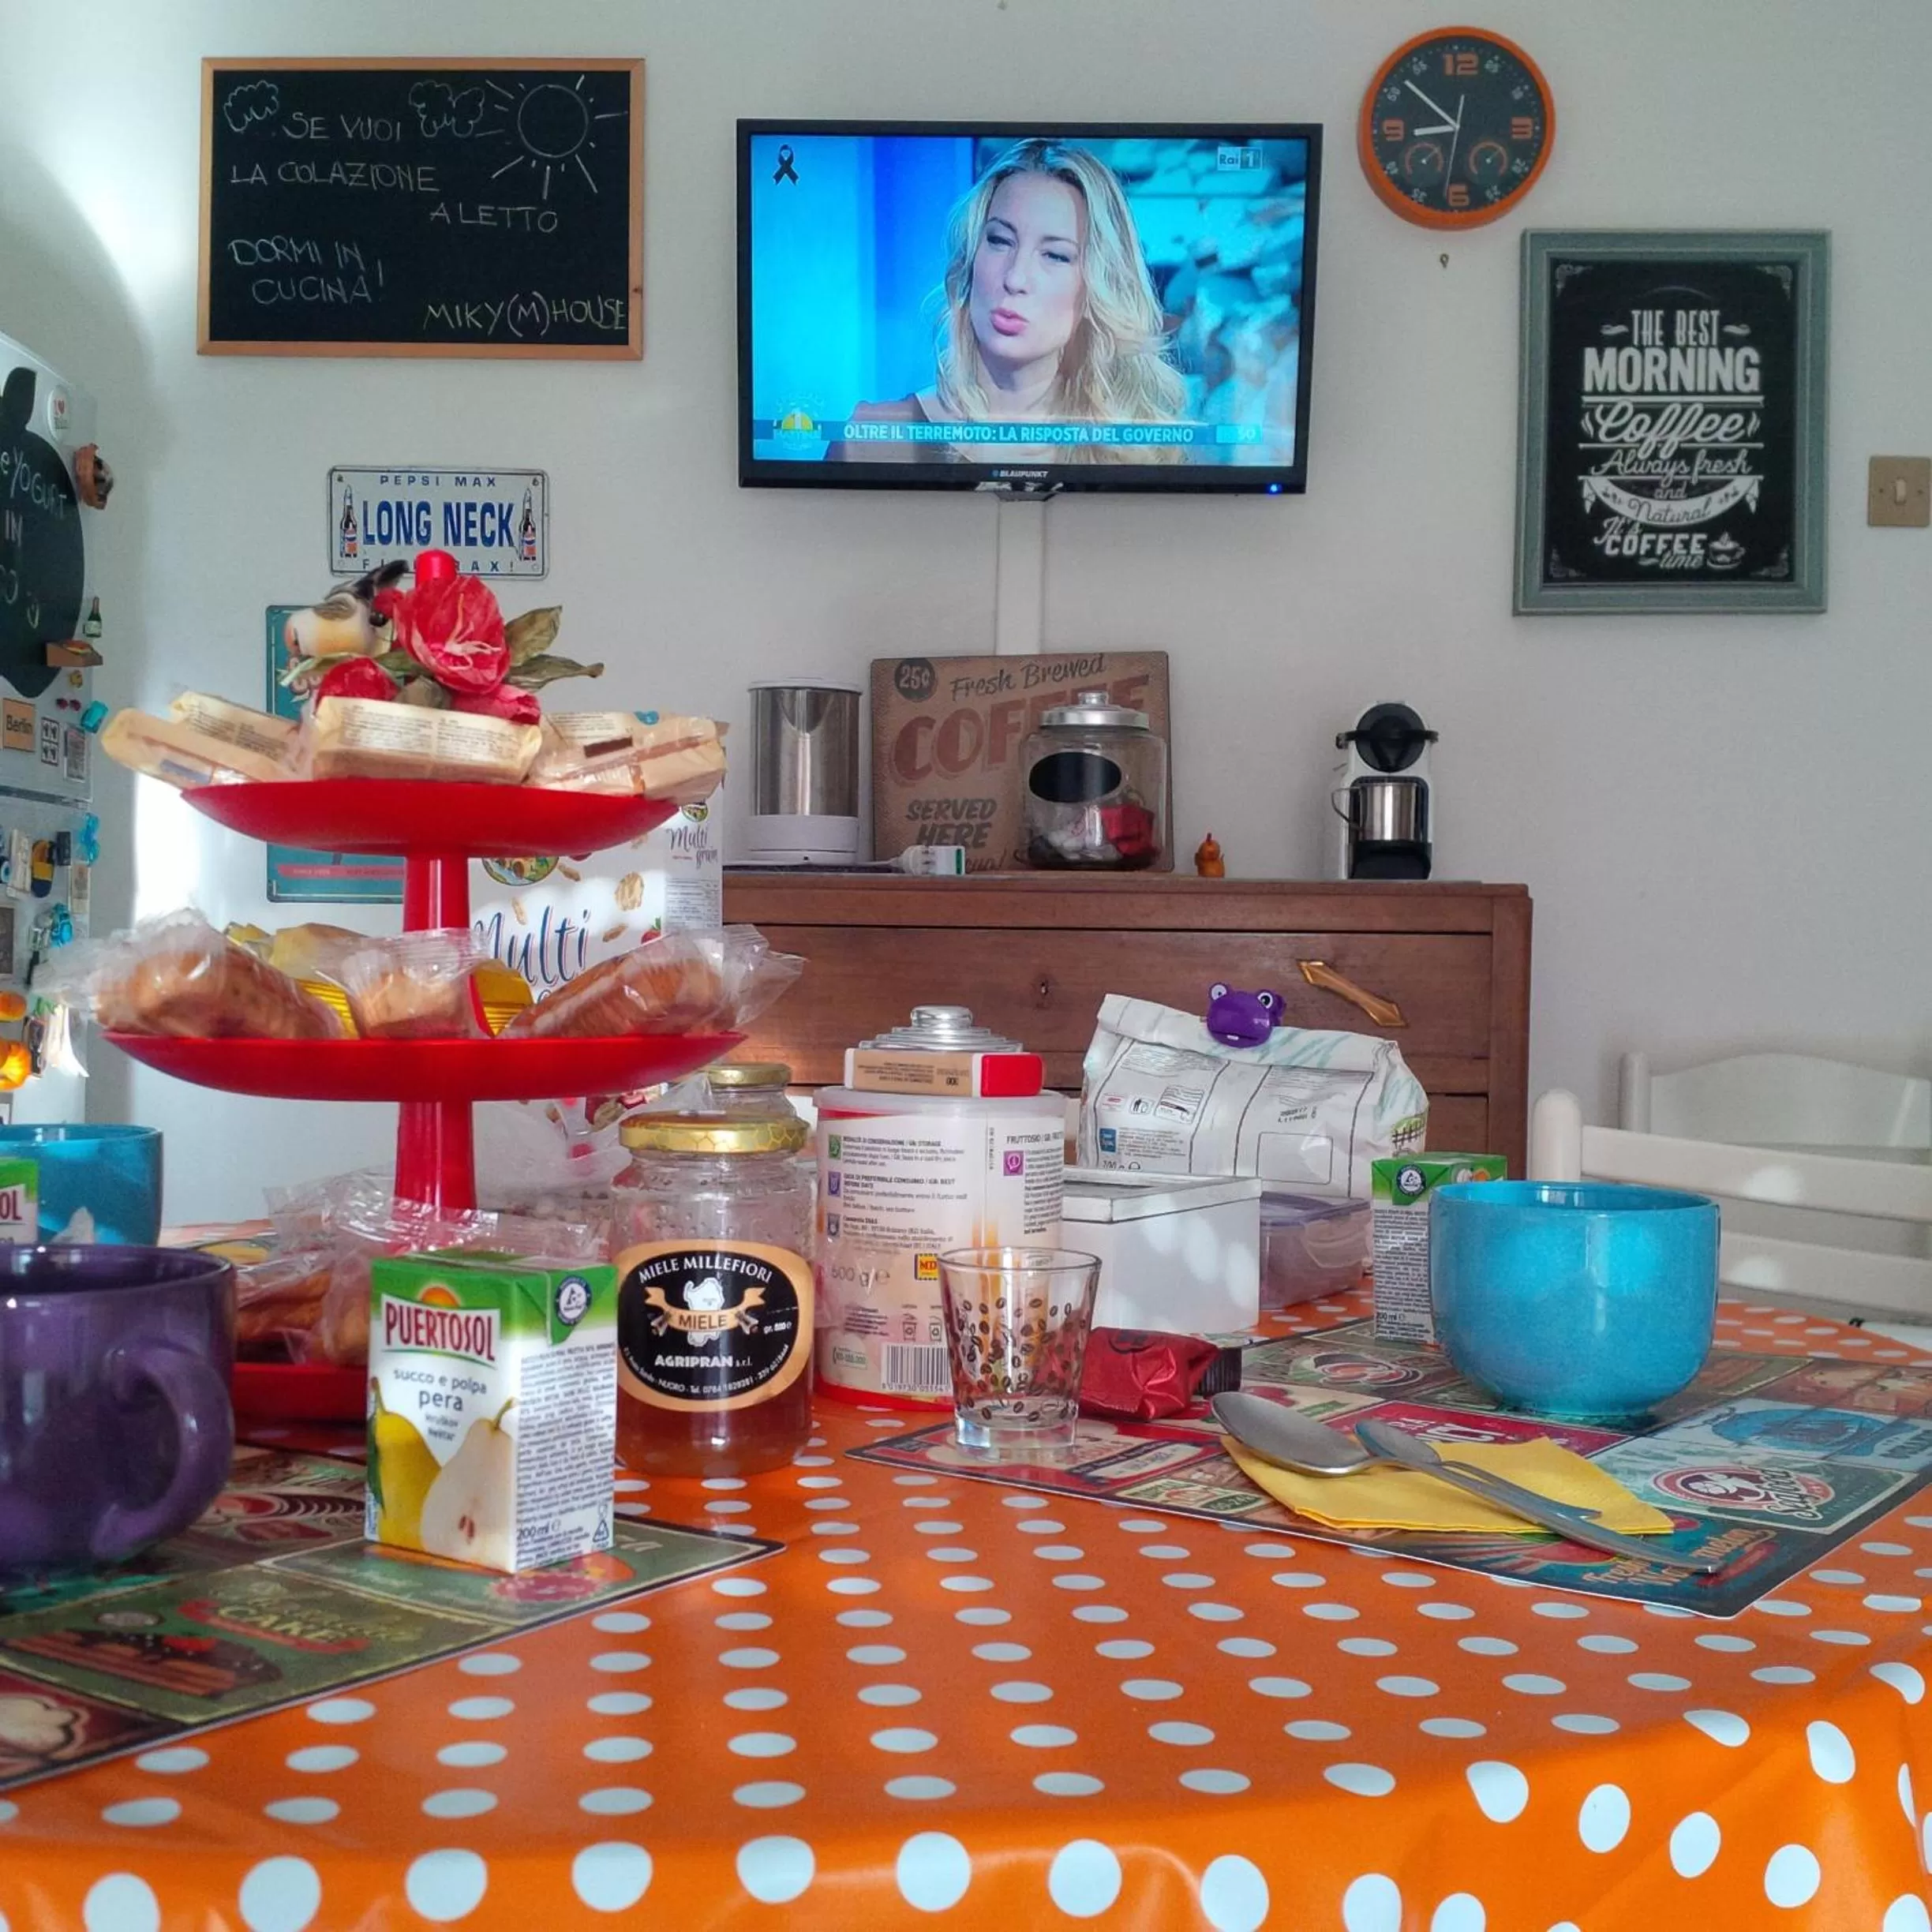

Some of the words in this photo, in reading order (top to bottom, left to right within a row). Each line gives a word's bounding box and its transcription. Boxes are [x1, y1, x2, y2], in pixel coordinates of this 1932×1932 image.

[1443, 52, 1479, 77] 12
[282, 111, 330, 140] SE
[339, 115, 402, 141] VUOI
[1383, 118, 1405, 142] 9
[1511, 117, 1533, 140] 3
[1219, 153, 1238, 165] Rai
[230, 163, 268, 185] LA
[278, 162, 440, 192] COLAZIONE
[1448, 183, 1470, 207] 6
[429, 202, 451, 224] A
[459, 206, 559, 234] LETTO
[228, 235, 322, 267] DORMI
[335, 241, 366, 271] IN
[1631, 309, 1665, 347] THE
[1675, 309, 1721, 347] BEST
[1583, 346, 1762, 393] MORNING
[844, 425, 889, 440] OLTRE
[890, 425, 904, 440] IL
[908, 425, 997, 441] TERREMOTO:
[998, 426, 1018, 441] LA
[1020, 427, 1089, 442] RISPOSTA
[1091, 428, 1120, 442] DEL
[1123, 428, 1194, 444] GOVERNO
[1593, 399, 1747, 460] Coffee
[1589, 448, 1691, 489] Always
[1693, 447, 1754, 485] fresh
[380, 474, 441, 486] PEPSI
[454, 476, 497, 488] MAX
[1653, 485, 1688, 500] and
[1627, 495, 1713, 524] Natural
[362, 500, 432, 546] LONG
[444, 501, 515, 548] NECK
[1604, 534, 1708, 556] COFFEE
[1658, 553, 1705, 570] time
[950, 668, 1017, 702] Fresh
[1020, 653, 1106, 689] Brewed
[6, 713, 33, 734] Berlin
[905, 799, 998, 822] SERVED
[666, 826, 709, 852] Multi
[916, 822, 993, 848] HERE
[638, 1255, 680, 1284] MIELE
[683, 1253, 773, 1284] MILLEFIORI
[831, 1266, 855, 1282] 500
[919, 1259, 938, 1271] MD
[385, 1301, 496, 1362] PUERTOSOL
[679, 1314, 728, 1331] MIELE
[654, 1354, 733, 1368] AGRIPRAN
[393, 1368, 435, 1383] succo
[438, 1376, 448, 1387] e
[451, 1376, 488, 1395] polpa
[419, 1390, 463, 1412] pera
[517, 1525, 536, 1540] 200
[537, 1522, 550, 1536] ml
